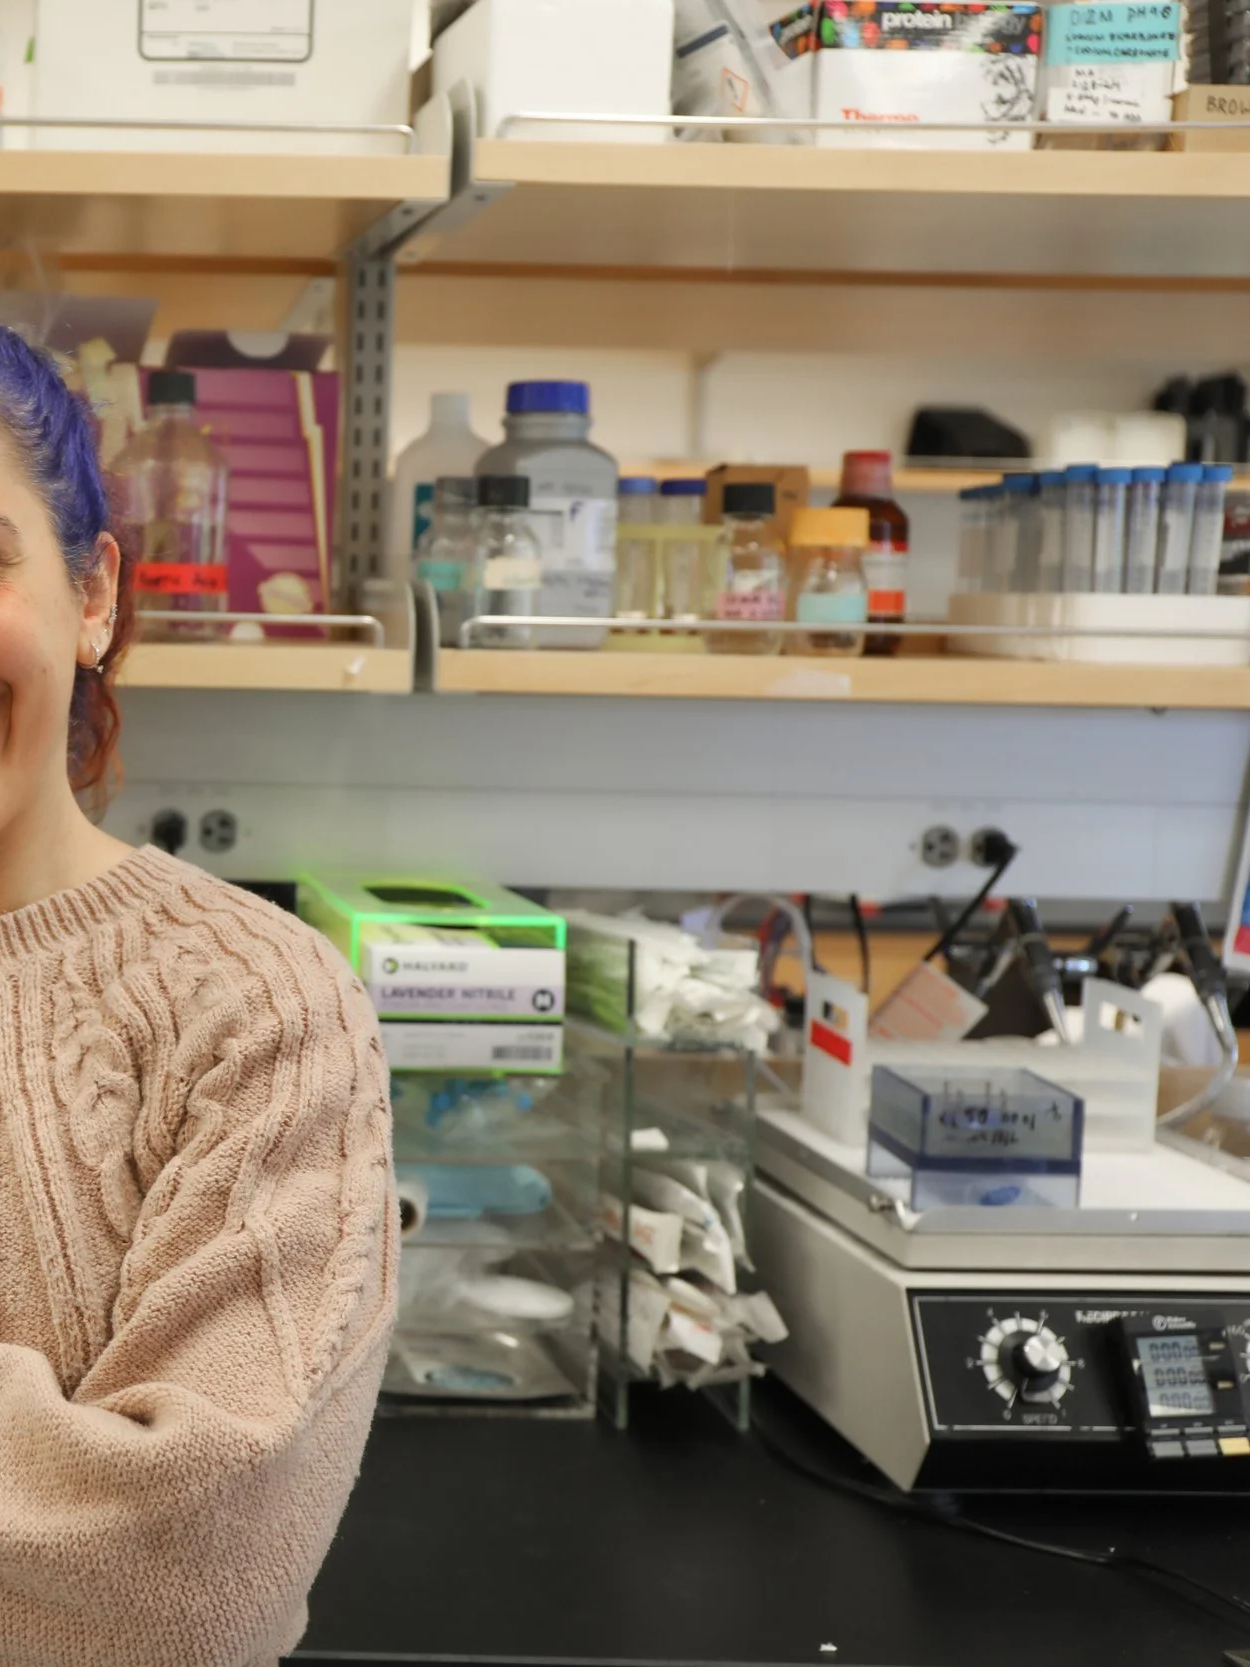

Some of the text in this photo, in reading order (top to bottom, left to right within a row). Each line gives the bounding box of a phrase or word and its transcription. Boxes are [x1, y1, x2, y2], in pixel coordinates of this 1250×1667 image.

[881, 10, 953, 31] protein
[381, 987, 517, 1001] LAVENDER NITRILE
